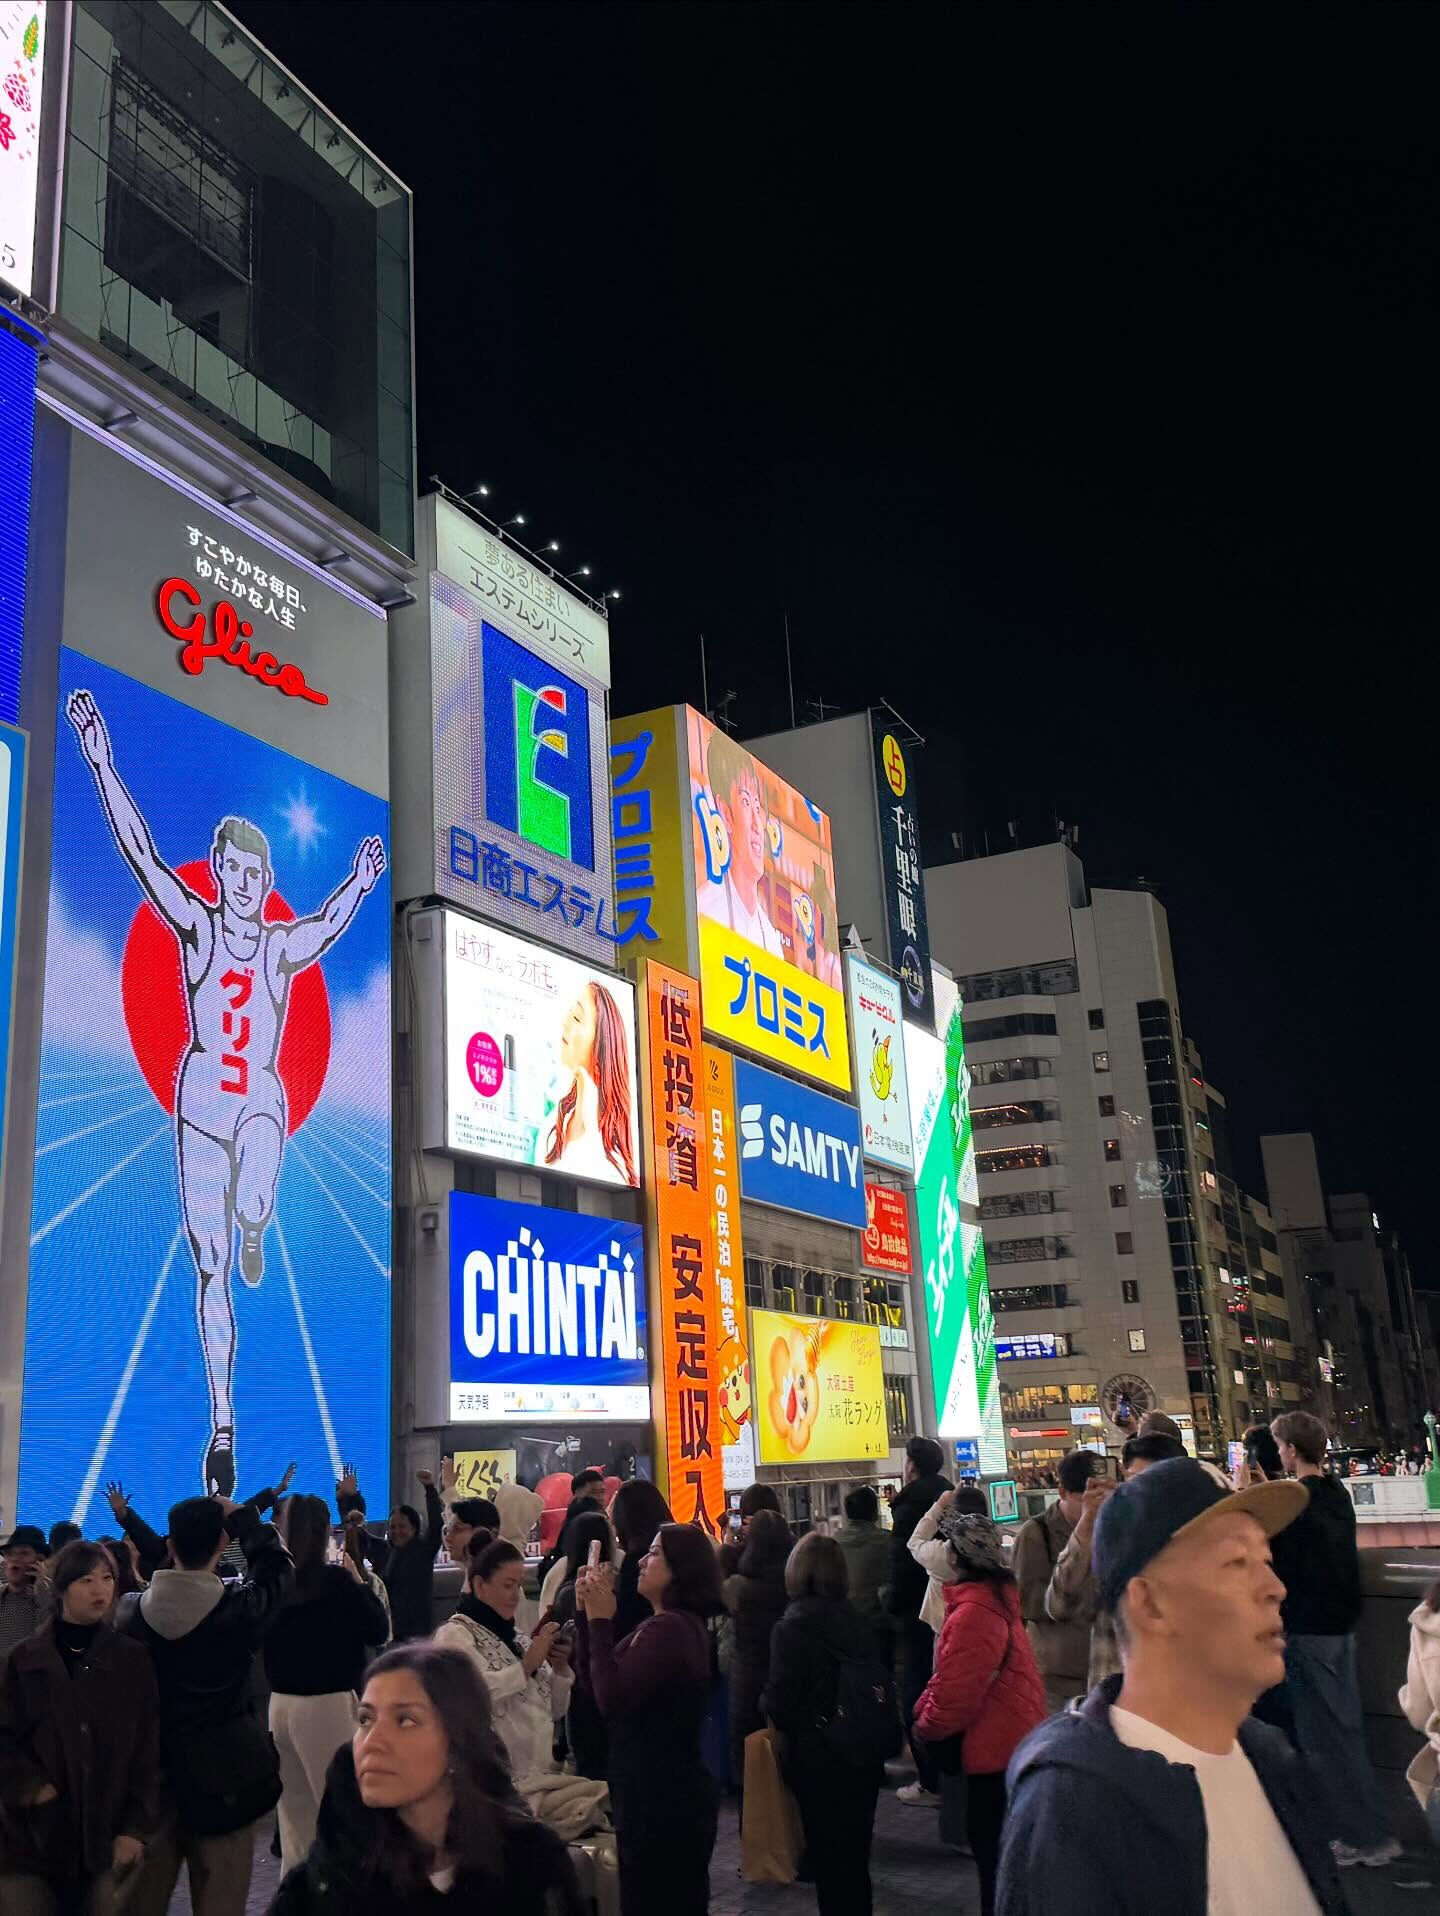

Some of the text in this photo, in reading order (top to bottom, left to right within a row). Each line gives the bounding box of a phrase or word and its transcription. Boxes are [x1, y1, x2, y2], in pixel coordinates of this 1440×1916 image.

[187, 525, 307, 612] すこやかな毎日、
[196, 556, 296, 631] ゆたかな人生
[470, 565, 585, 664] エステムシリーズ
[485, 538, 570, 617] 夢ある住まい
[159, 577, 329, 706] Glico
[450, 826, 619, 943] 日商エステム
[610, 729, 660, 947] プロミス
[219, 966, 257, 1096] グリコ
[723, 955, 832, 1061] プロミス
[769, 1114, 860, 1189] SAMTY
[463, 1226, 639, 1360] CHINTAI
[661, 978, 718, 1536] 低投資 安定収入
